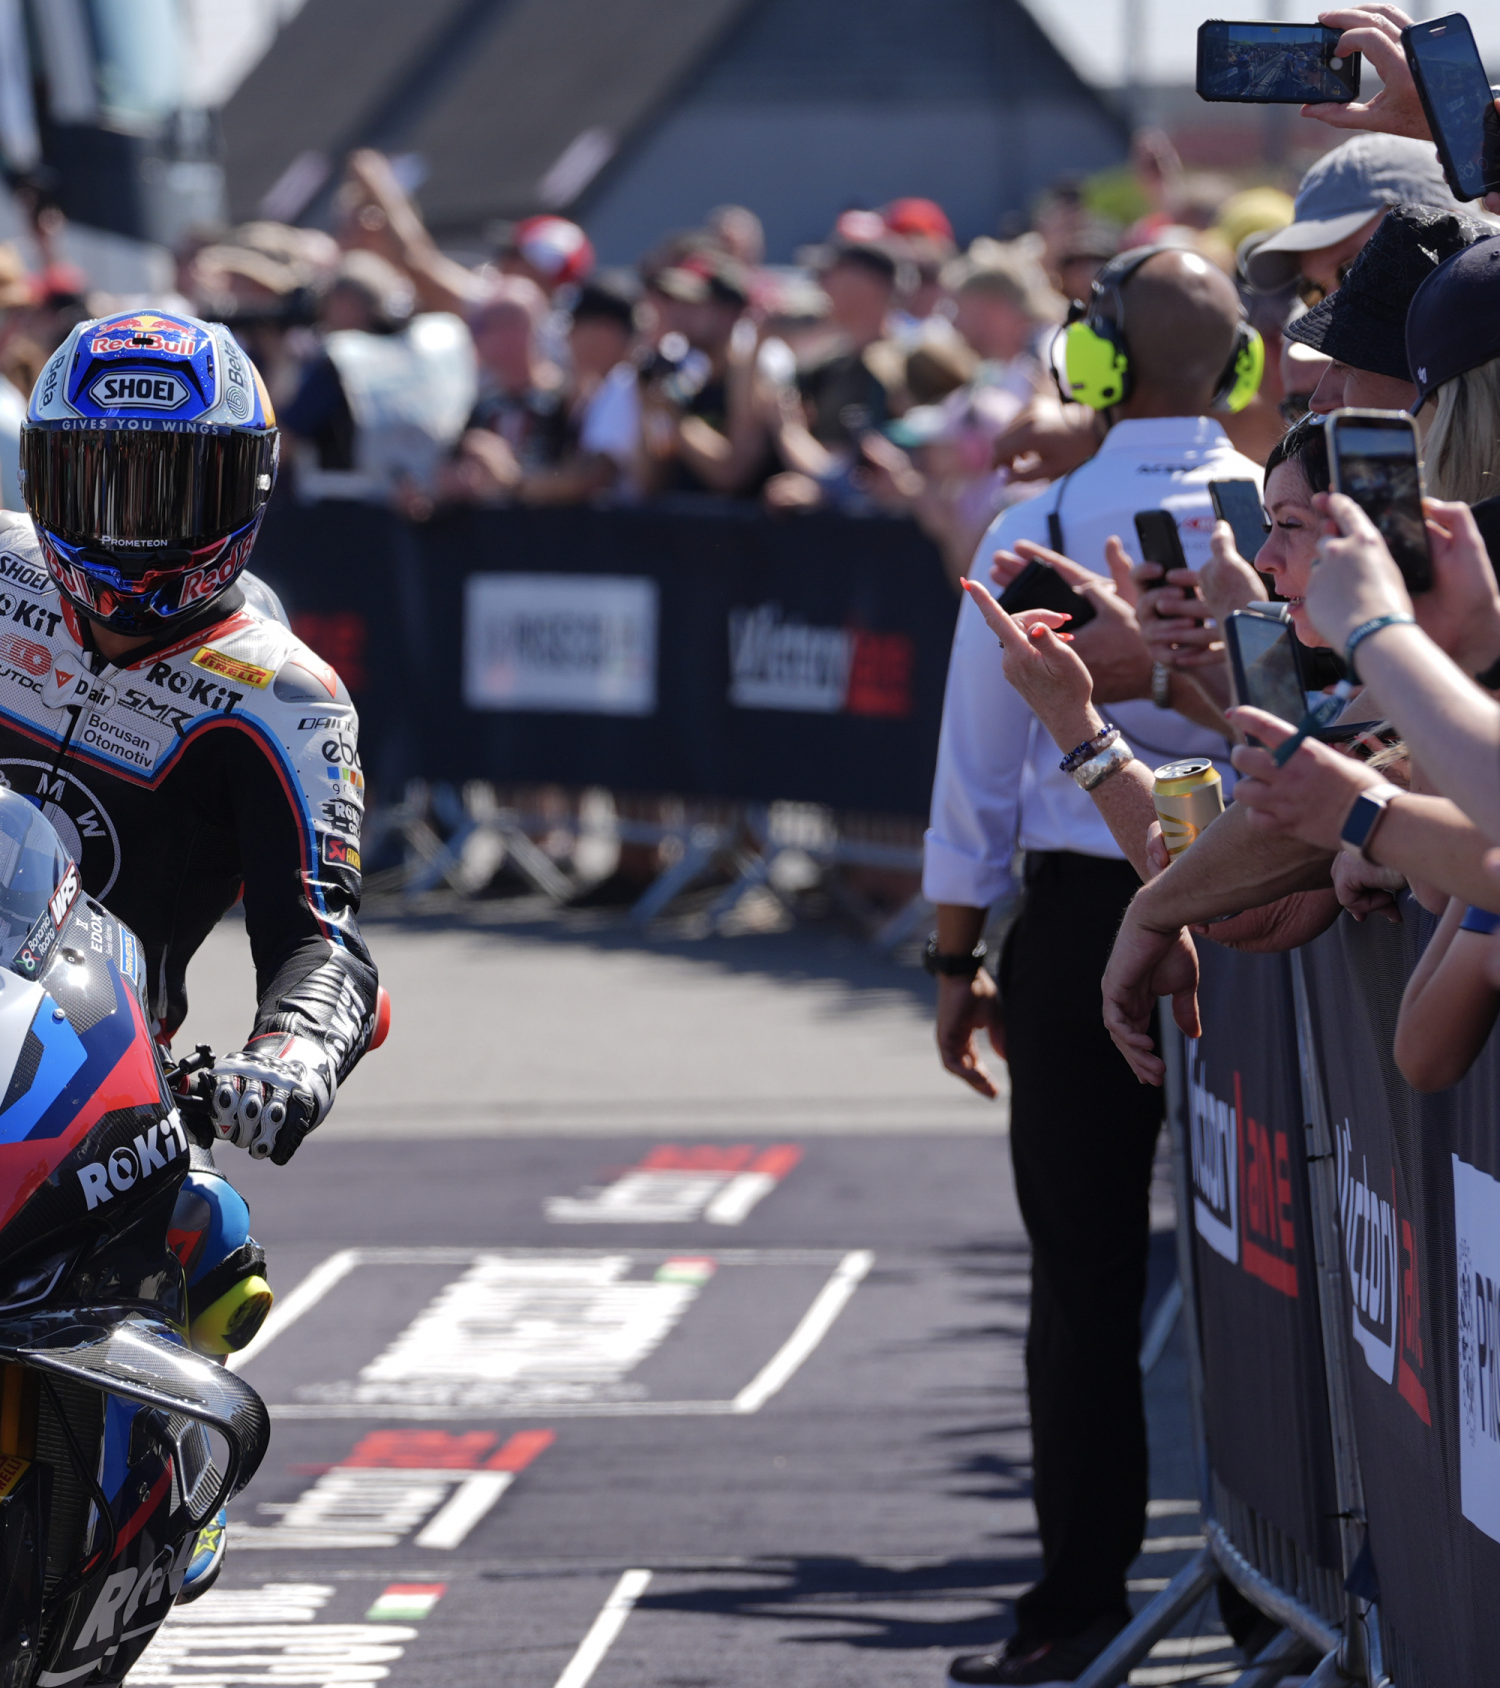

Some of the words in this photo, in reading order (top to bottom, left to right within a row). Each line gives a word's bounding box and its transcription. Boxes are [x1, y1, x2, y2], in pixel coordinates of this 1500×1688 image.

[91, 333, 142, 353] Red
[144, 333, 196, 355] Bull
[225, 339, 244, 388] Beta
[43, 354, 65, 406] Beta
[104, 378, 174, 401] SHOEI
[62, 419, 107, 431] GIVES
[116, 419, 152, 431] YOU
[162, 421, 219, 435] WINGS
[101, 535, 168, 547] PROMETEON
[179, 541, 240, 608] Red
[199, 651, 267, 685] PIRELLI
[146, 661, 244, 715] ROKiT
[88, 713, 150, 751] Borusan
[118, 688, 194, 740] SMR
[84, 729, 152, 767] Otomotiv
[28, 913, 51, 952] Bonamici
[38, 927, 55, 956] Racing
[91, 912, 103, 953] EDOX
[77, 1108, 187, 1211] ROKiT
[73, 1531, 200, 1650] ROK
